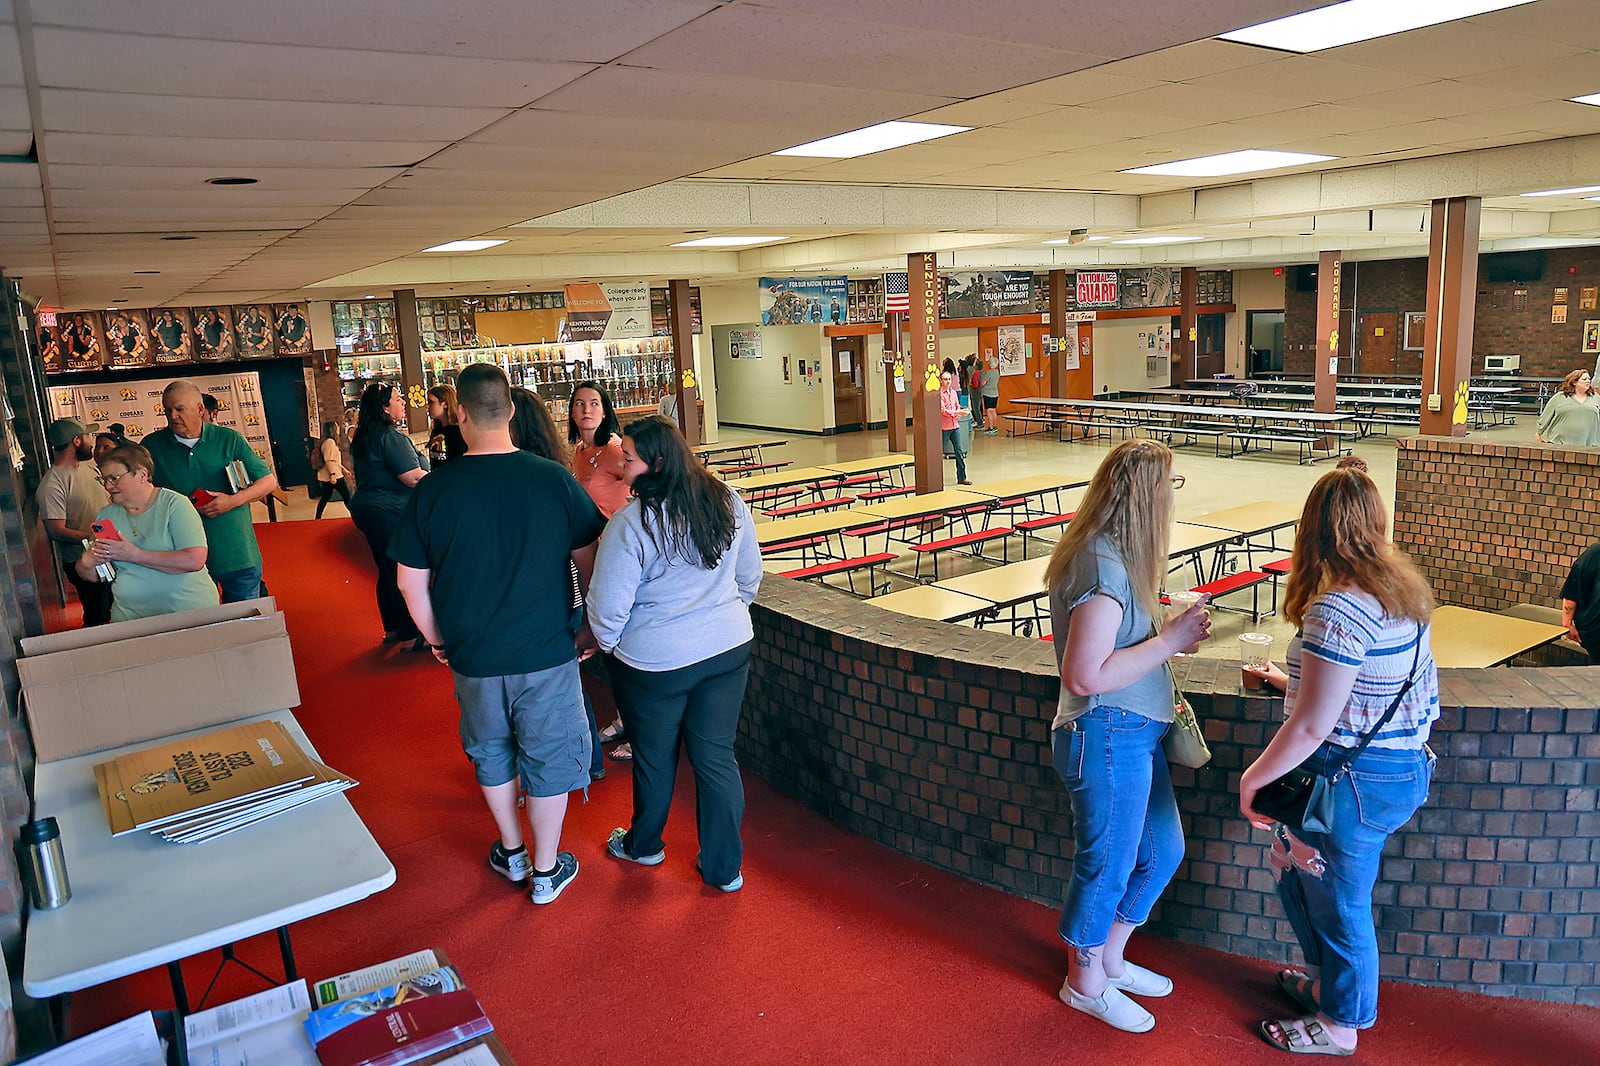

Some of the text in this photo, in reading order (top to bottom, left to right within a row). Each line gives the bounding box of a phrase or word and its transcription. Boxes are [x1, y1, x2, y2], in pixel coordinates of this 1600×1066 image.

[1078, 272, 1107, 283] NATIONAL
[1019, 283, 1029, 291] YOU
[1077, 283, 1117, 303] GUARD
[982, 291, 1029, 300] TOUGH ENOUGH?
[924, 254, 935, 359] KENTON RIDGE
[114, 357, 147, 365] NEELY
[156, 354, 191, 362] ROBINSON
[199, 751, 233, 781] CLASS OF
[224, 751, 254, 769] 2023
[172, 750, 211, 796] KENTON RIDGE
